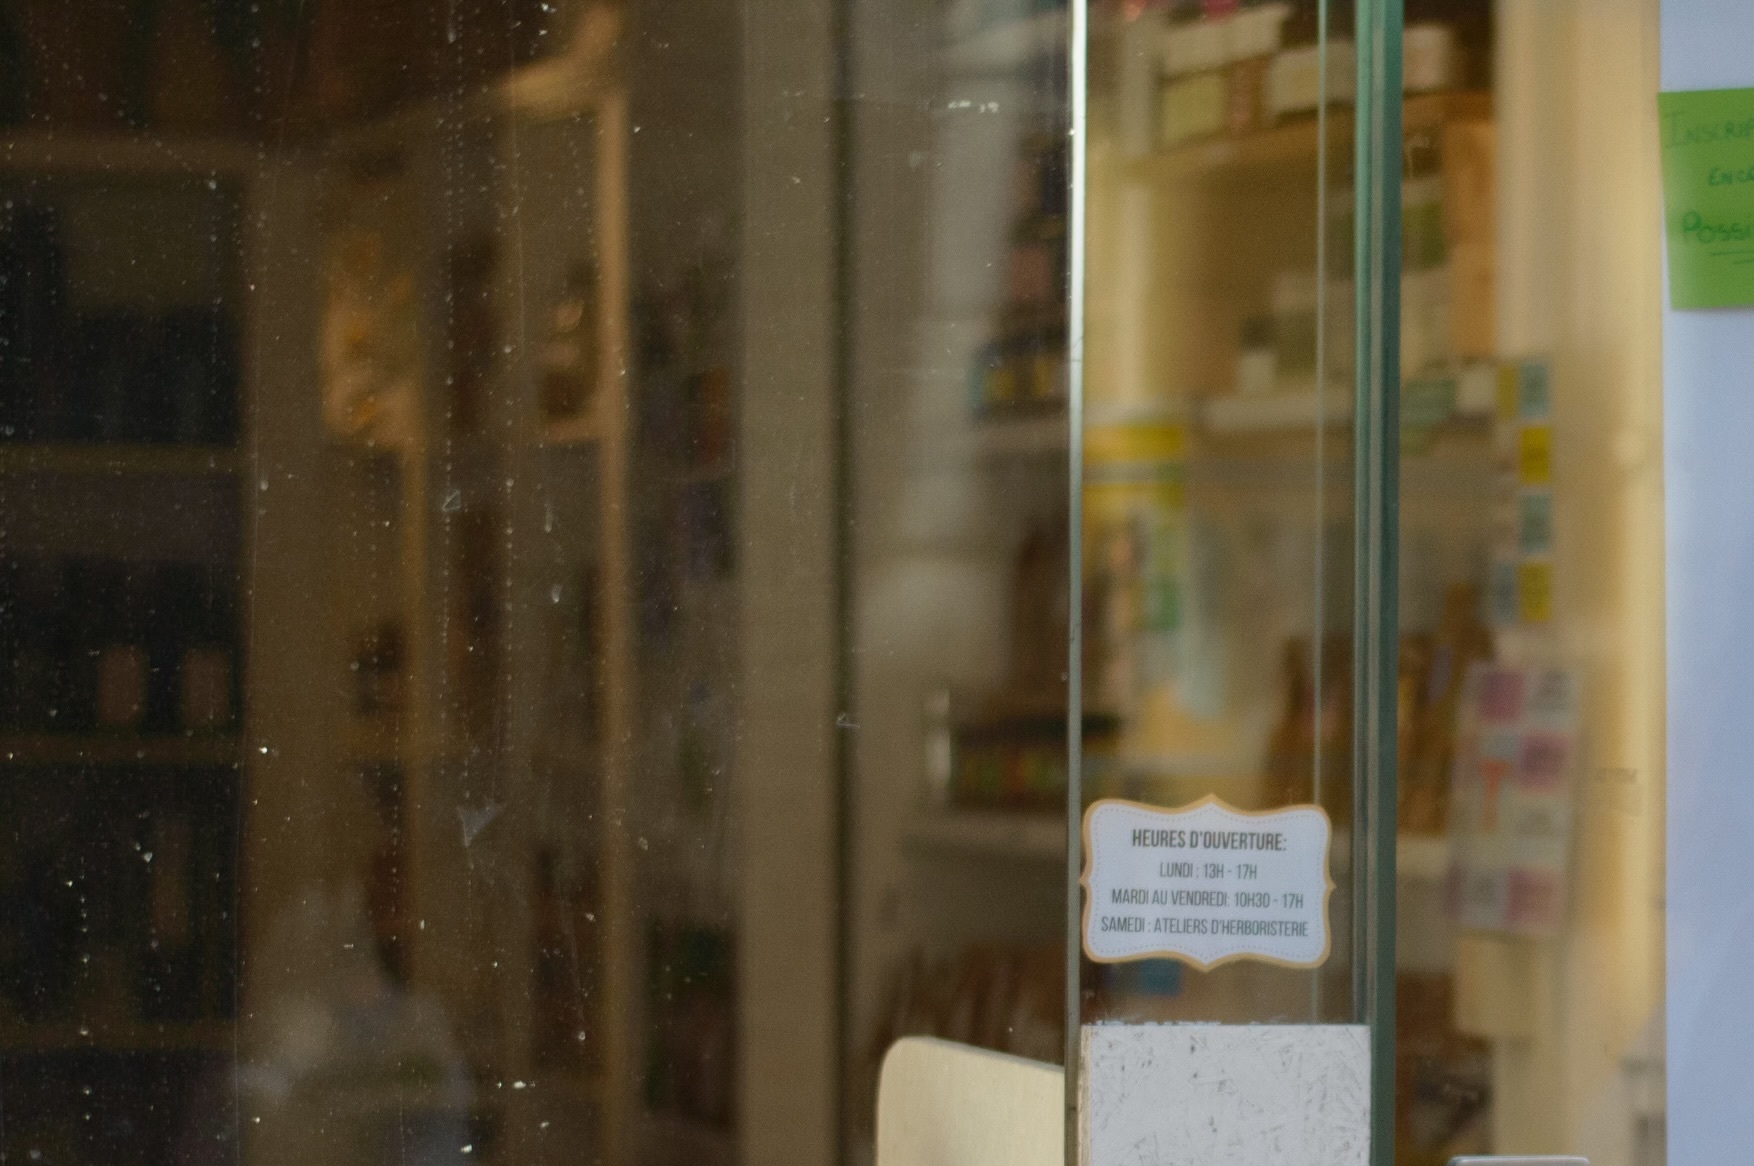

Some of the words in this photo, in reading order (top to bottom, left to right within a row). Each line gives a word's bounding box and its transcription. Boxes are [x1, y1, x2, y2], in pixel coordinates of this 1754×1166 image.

[1132, 829, 1186, 849] HEURES
[1189, 830, 1287, 851] D'OUVERTURE:
[1159, 862, 1193, 878] LUNDI
[1203, 863, 1224, 879] 13H
[1236, 863, 1257, 880] 17H
[1111, 888, 1149, 905] MARDI
[1152, 889, 1169, 905] AU
[1171, 890, 1230, 907] VENDREDI:
[1234, 892, 1270, 908] 10H30
[1282, 893, 1304, 909] 17H
[1101, 916, 1145, 933] SAMEDI
[1153, 917, 1208, 935] ATELIERS
[1210, 919, 1309, 937] D'HERBORISTERIE
